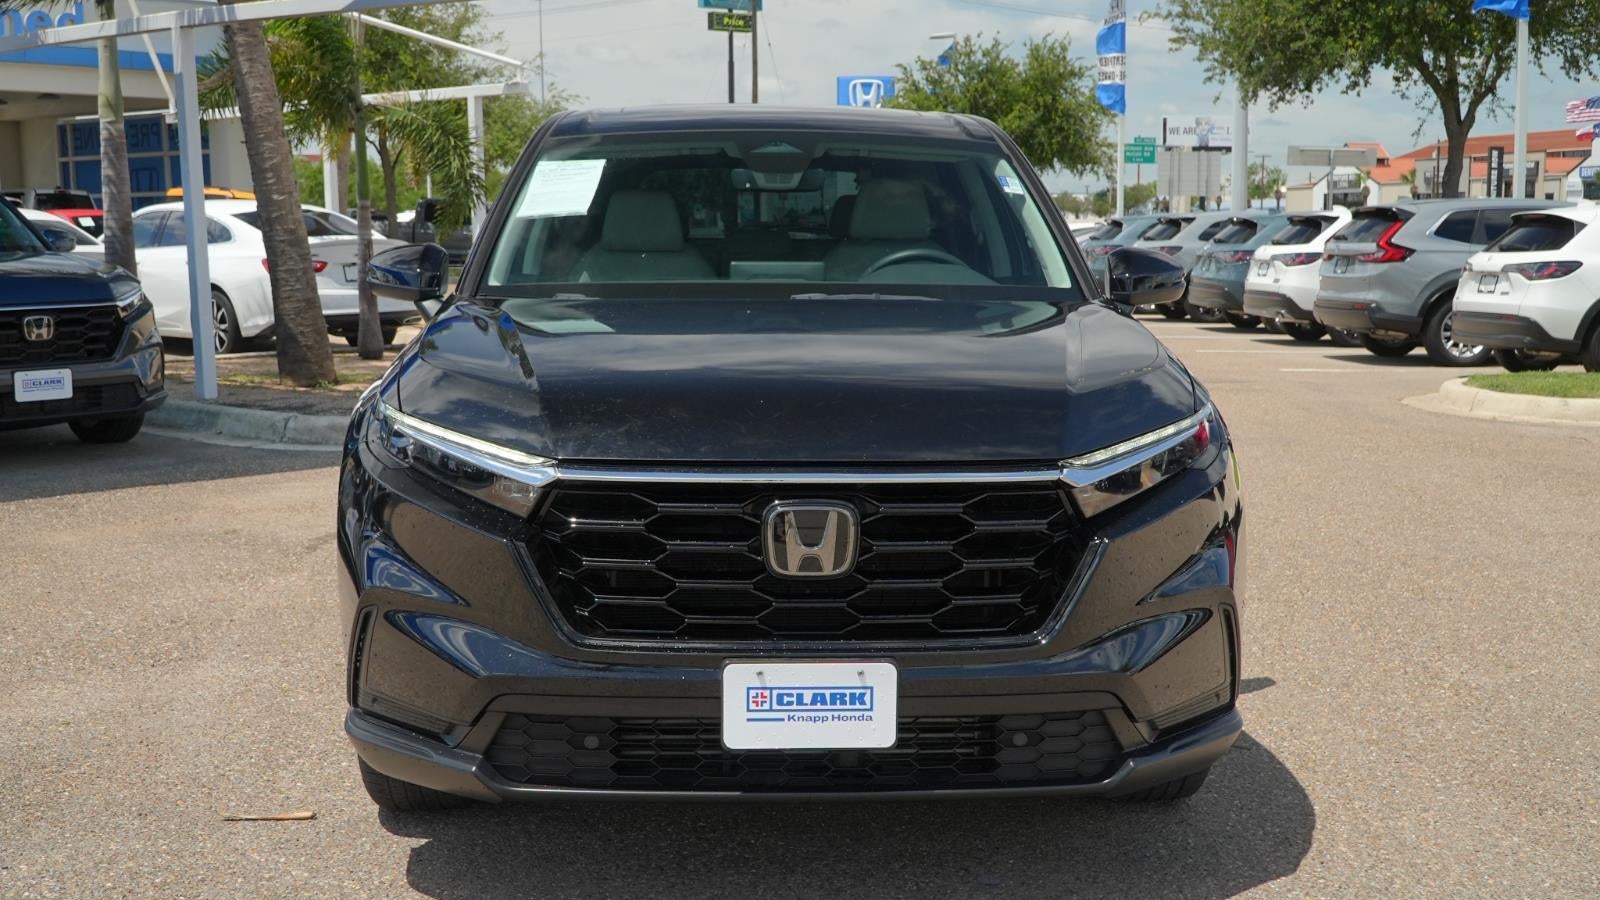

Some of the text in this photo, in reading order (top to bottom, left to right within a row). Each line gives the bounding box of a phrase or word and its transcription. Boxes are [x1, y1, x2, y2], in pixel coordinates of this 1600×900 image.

[1168, 127, 1183, 136] WE
[32, 378, 62, 386] CLARK
[776, 692, 867, 707] CLARK
[787, 714, 873, 724] Knapp Honda
